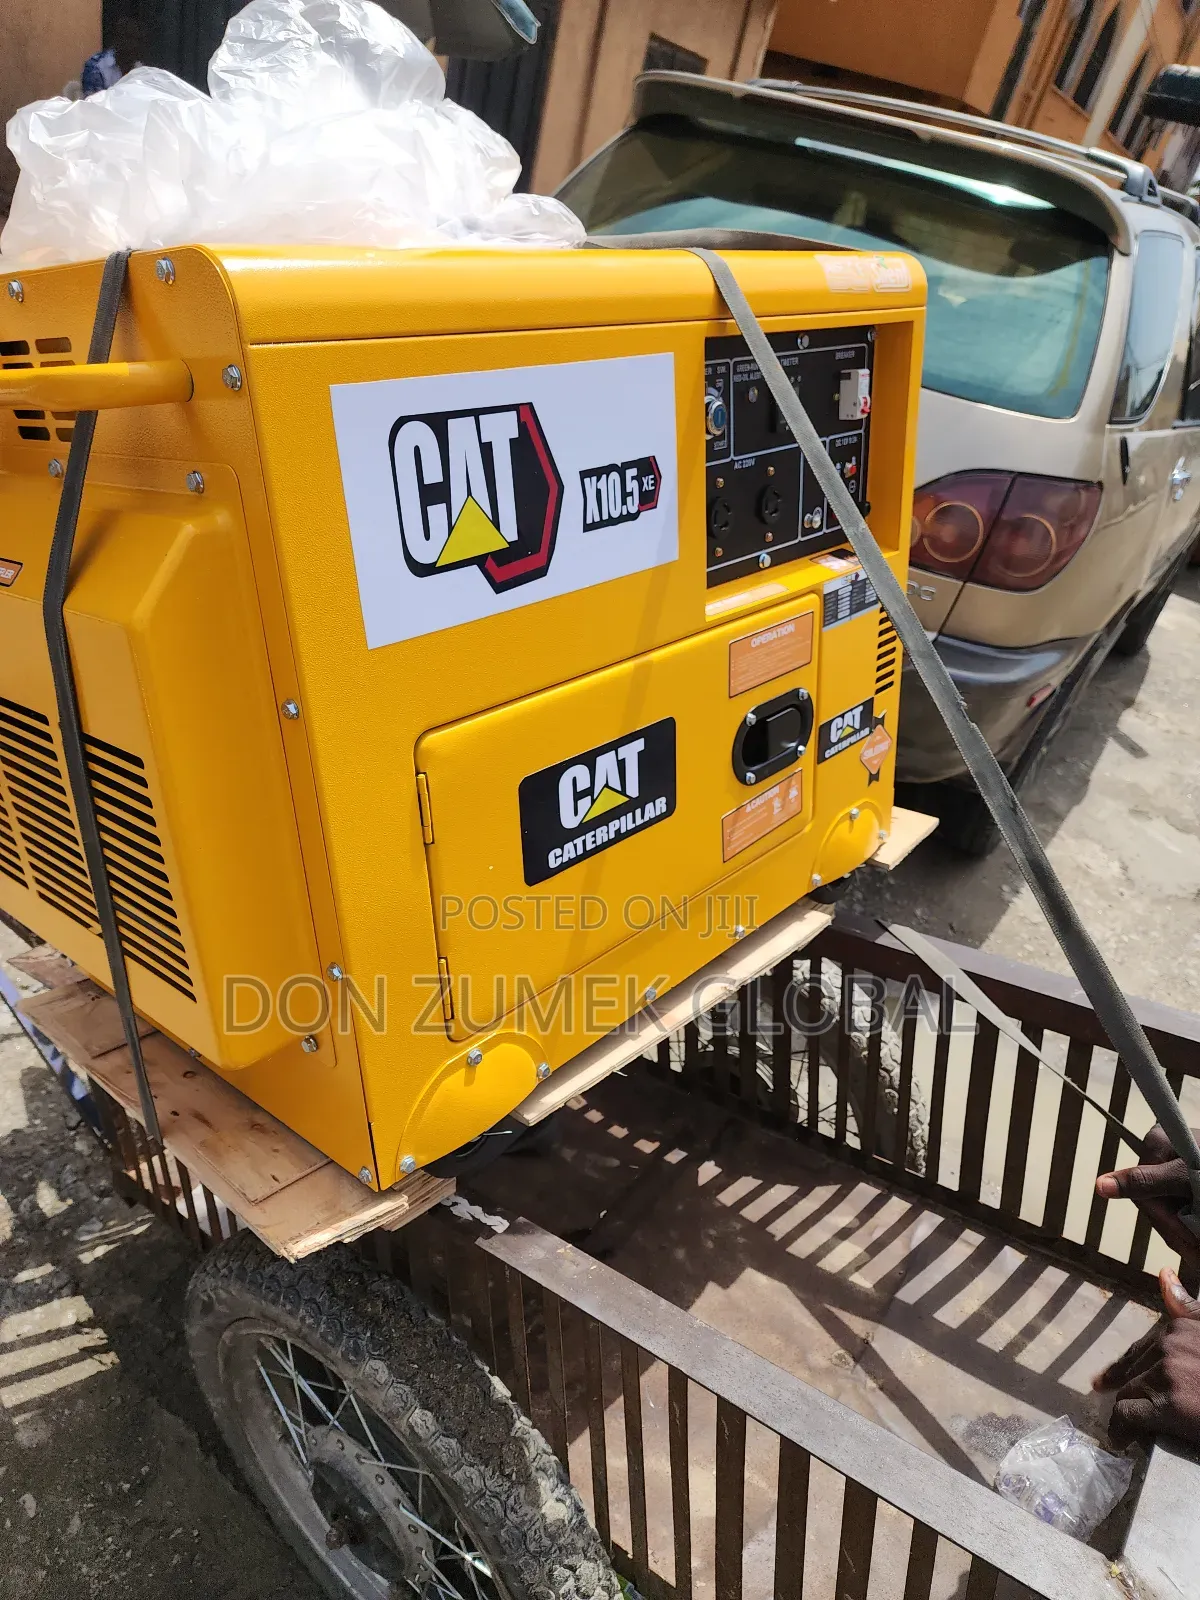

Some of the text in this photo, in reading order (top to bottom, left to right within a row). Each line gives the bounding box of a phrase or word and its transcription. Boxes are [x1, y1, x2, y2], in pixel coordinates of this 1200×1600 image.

[733, 459, 743, 470] AC
[394, 409, 520, 565] CAT
[583, 467, 656, 525] X10.5 XE
[750, 623, 796, 648] OPERATION
[824, 726, 870, 759] CATERPILLAR
[829, 705, 864, 743] CAT
[558, 737, 645, 829] CAT
[751, 785, 780, 809] CAUTION
[548, 796, 667, 869] CATERPILLAR
